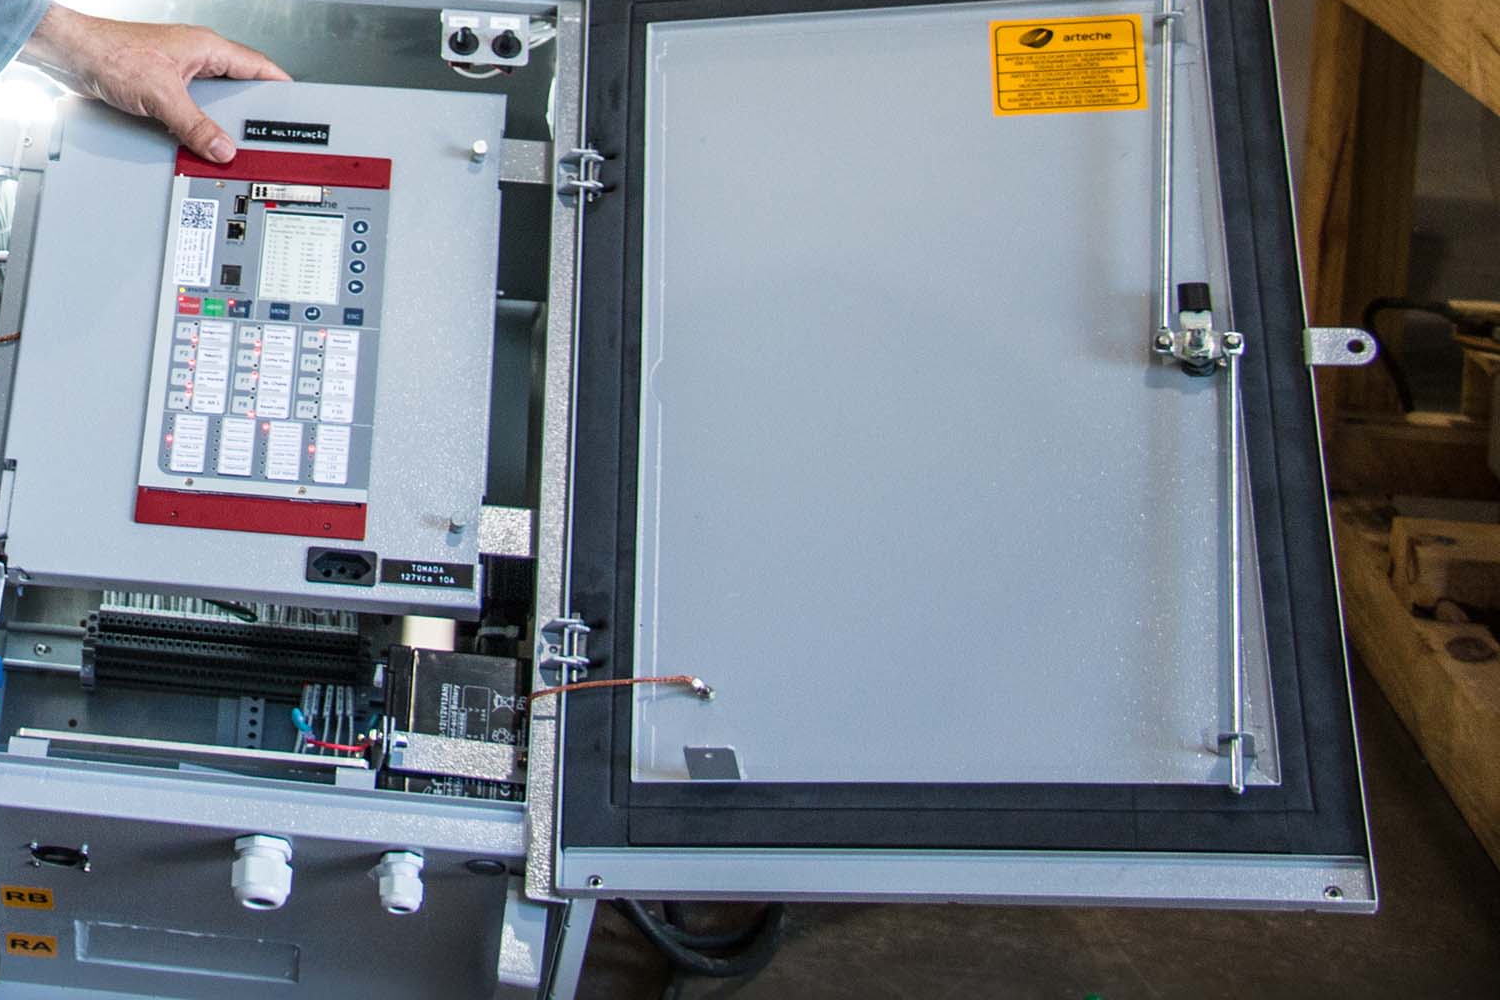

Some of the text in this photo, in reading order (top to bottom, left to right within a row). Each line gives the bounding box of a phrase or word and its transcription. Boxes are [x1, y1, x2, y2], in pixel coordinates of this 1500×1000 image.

[1063, 32, 1113, 43] arteche
[411, 564, 444, 575] TOMADA
[400, 573, 455, 584] 127Vca 10A
[5, 890, 49, 904] RB
[10, 938, 53, 952] RA
